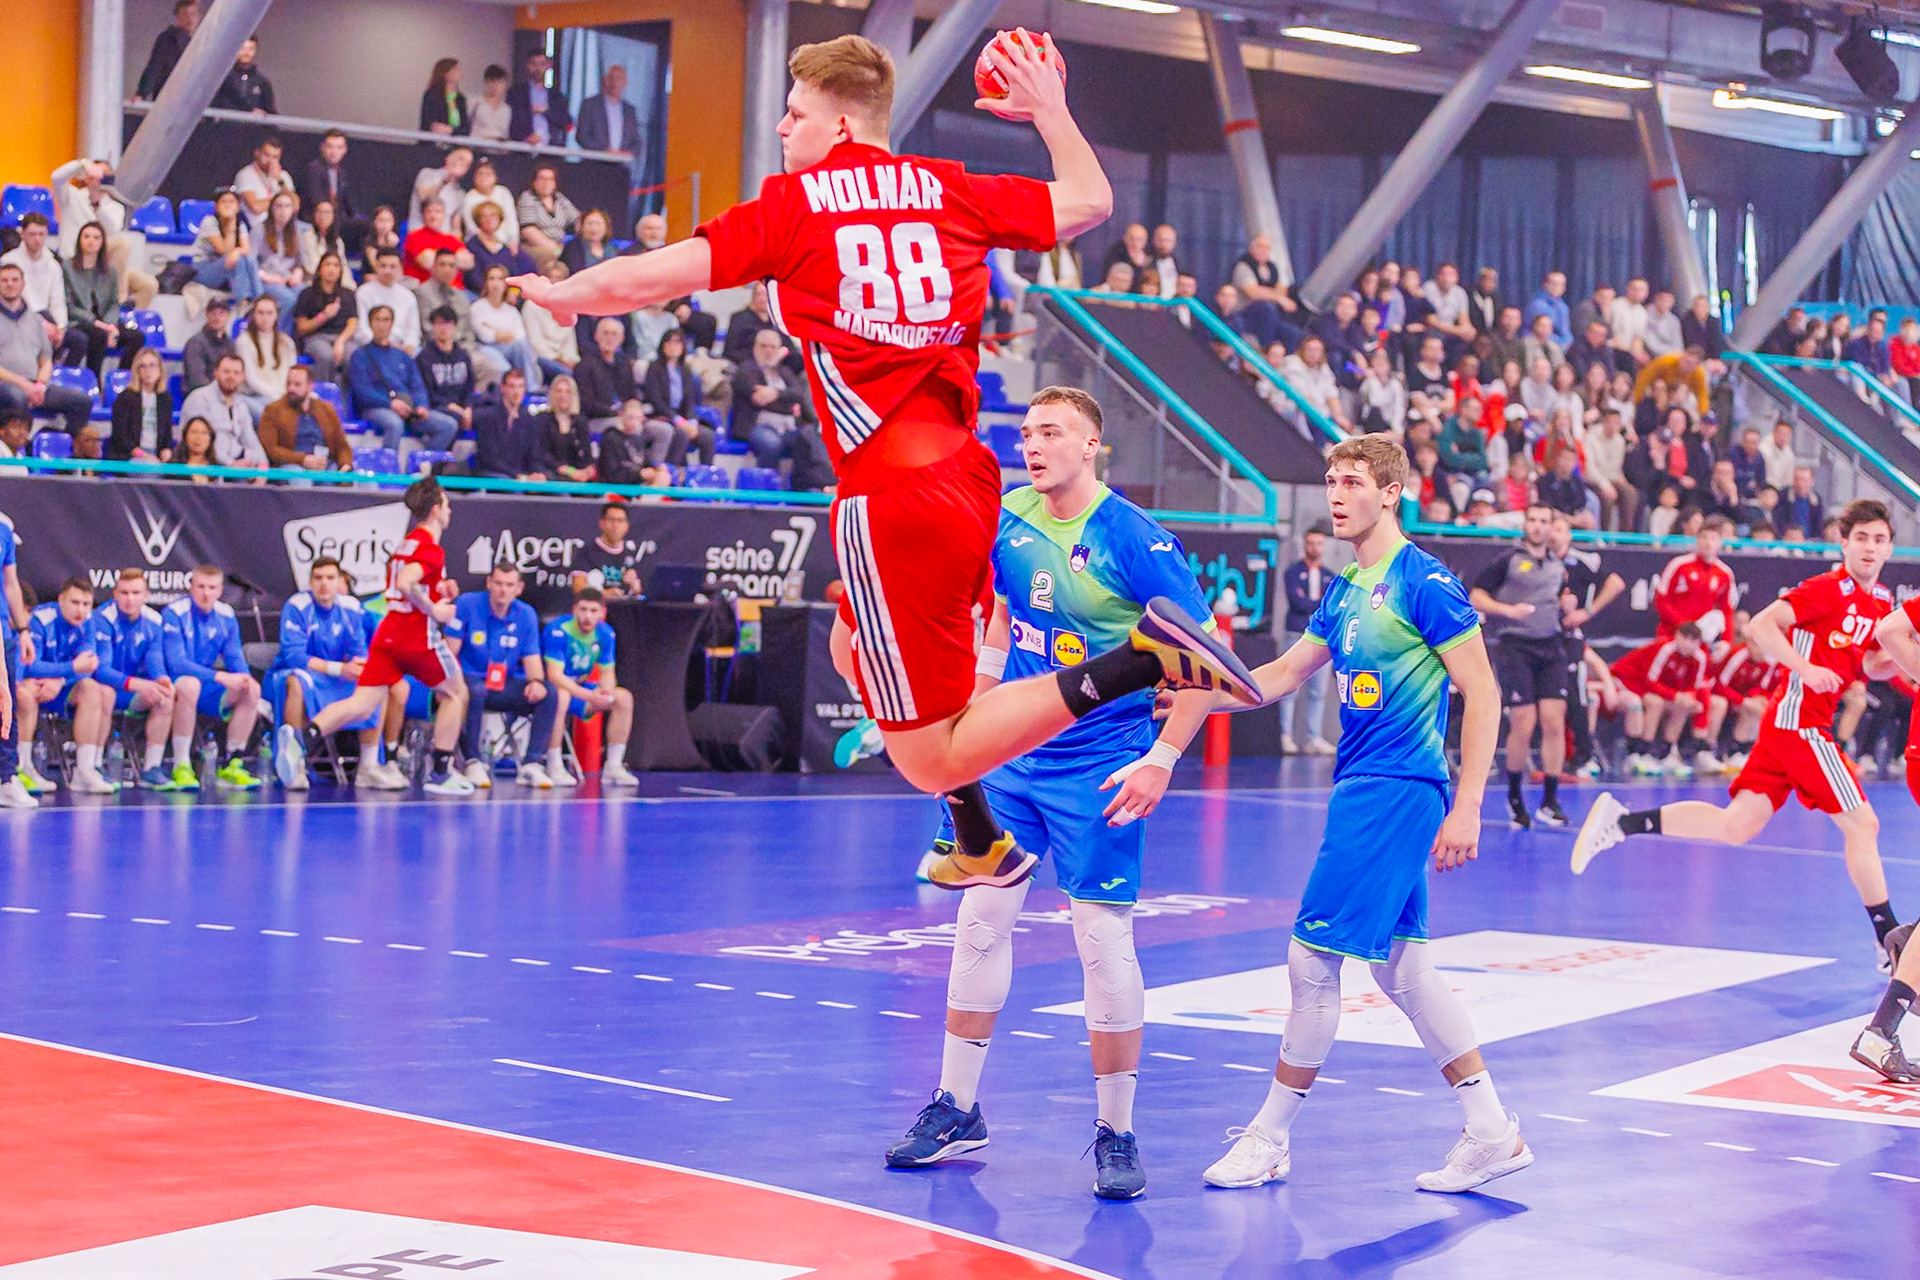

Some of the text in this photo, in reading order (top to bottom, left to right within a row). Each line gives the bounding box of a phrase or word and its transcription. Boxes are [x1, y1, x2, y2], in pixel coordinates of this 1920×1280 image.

[801, 162, 943, 213] MOLNÁR
[835, 222, 953, 323] 88
[706, 540, 774, 571] seine
[771, 516, 817, 572] 77
[1030, 569, 1054, 612] 2
[1342, 615, 1360, 656] 6
[1851, 614, 1874, 646] 77
